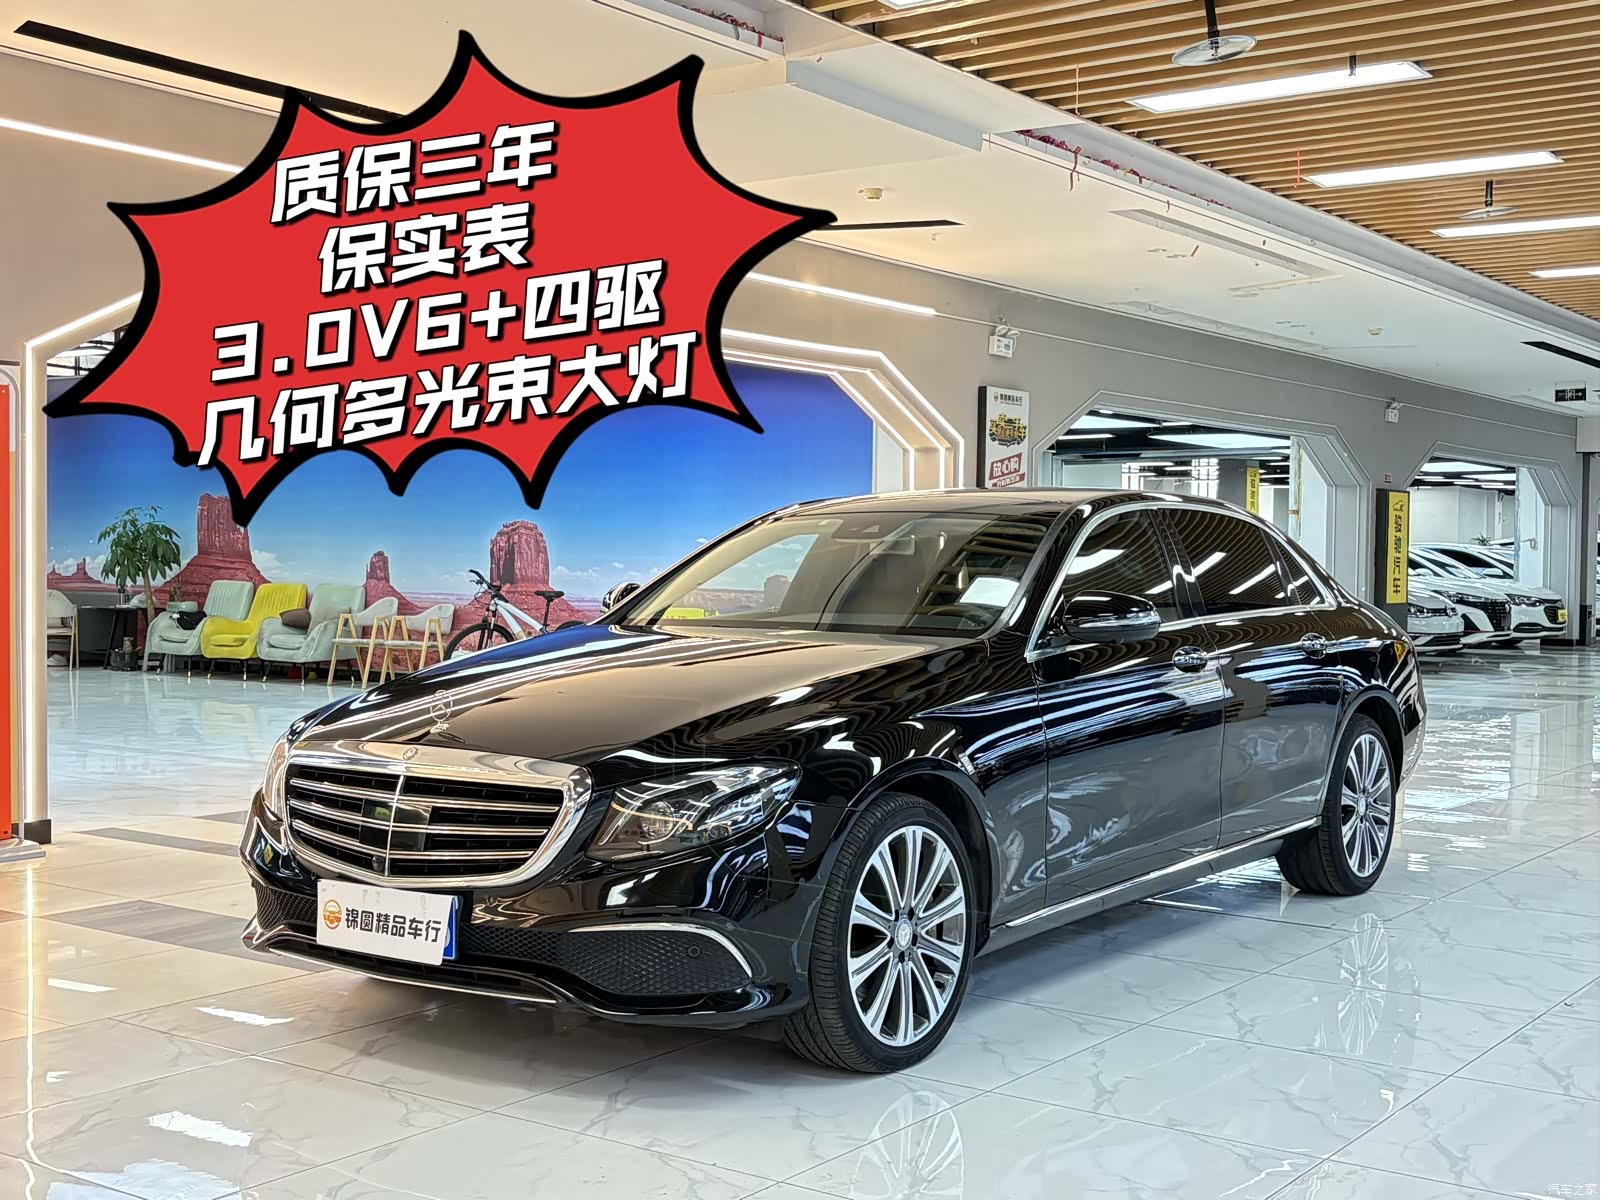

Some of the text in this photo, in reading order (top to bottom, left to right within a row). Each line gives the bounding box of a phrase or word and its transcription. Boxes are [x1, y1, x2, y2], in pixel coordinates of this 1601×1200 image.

[993, 456, 1019, 477] 放心购
[346, 907, 441, 942] 锦圆精品车行
